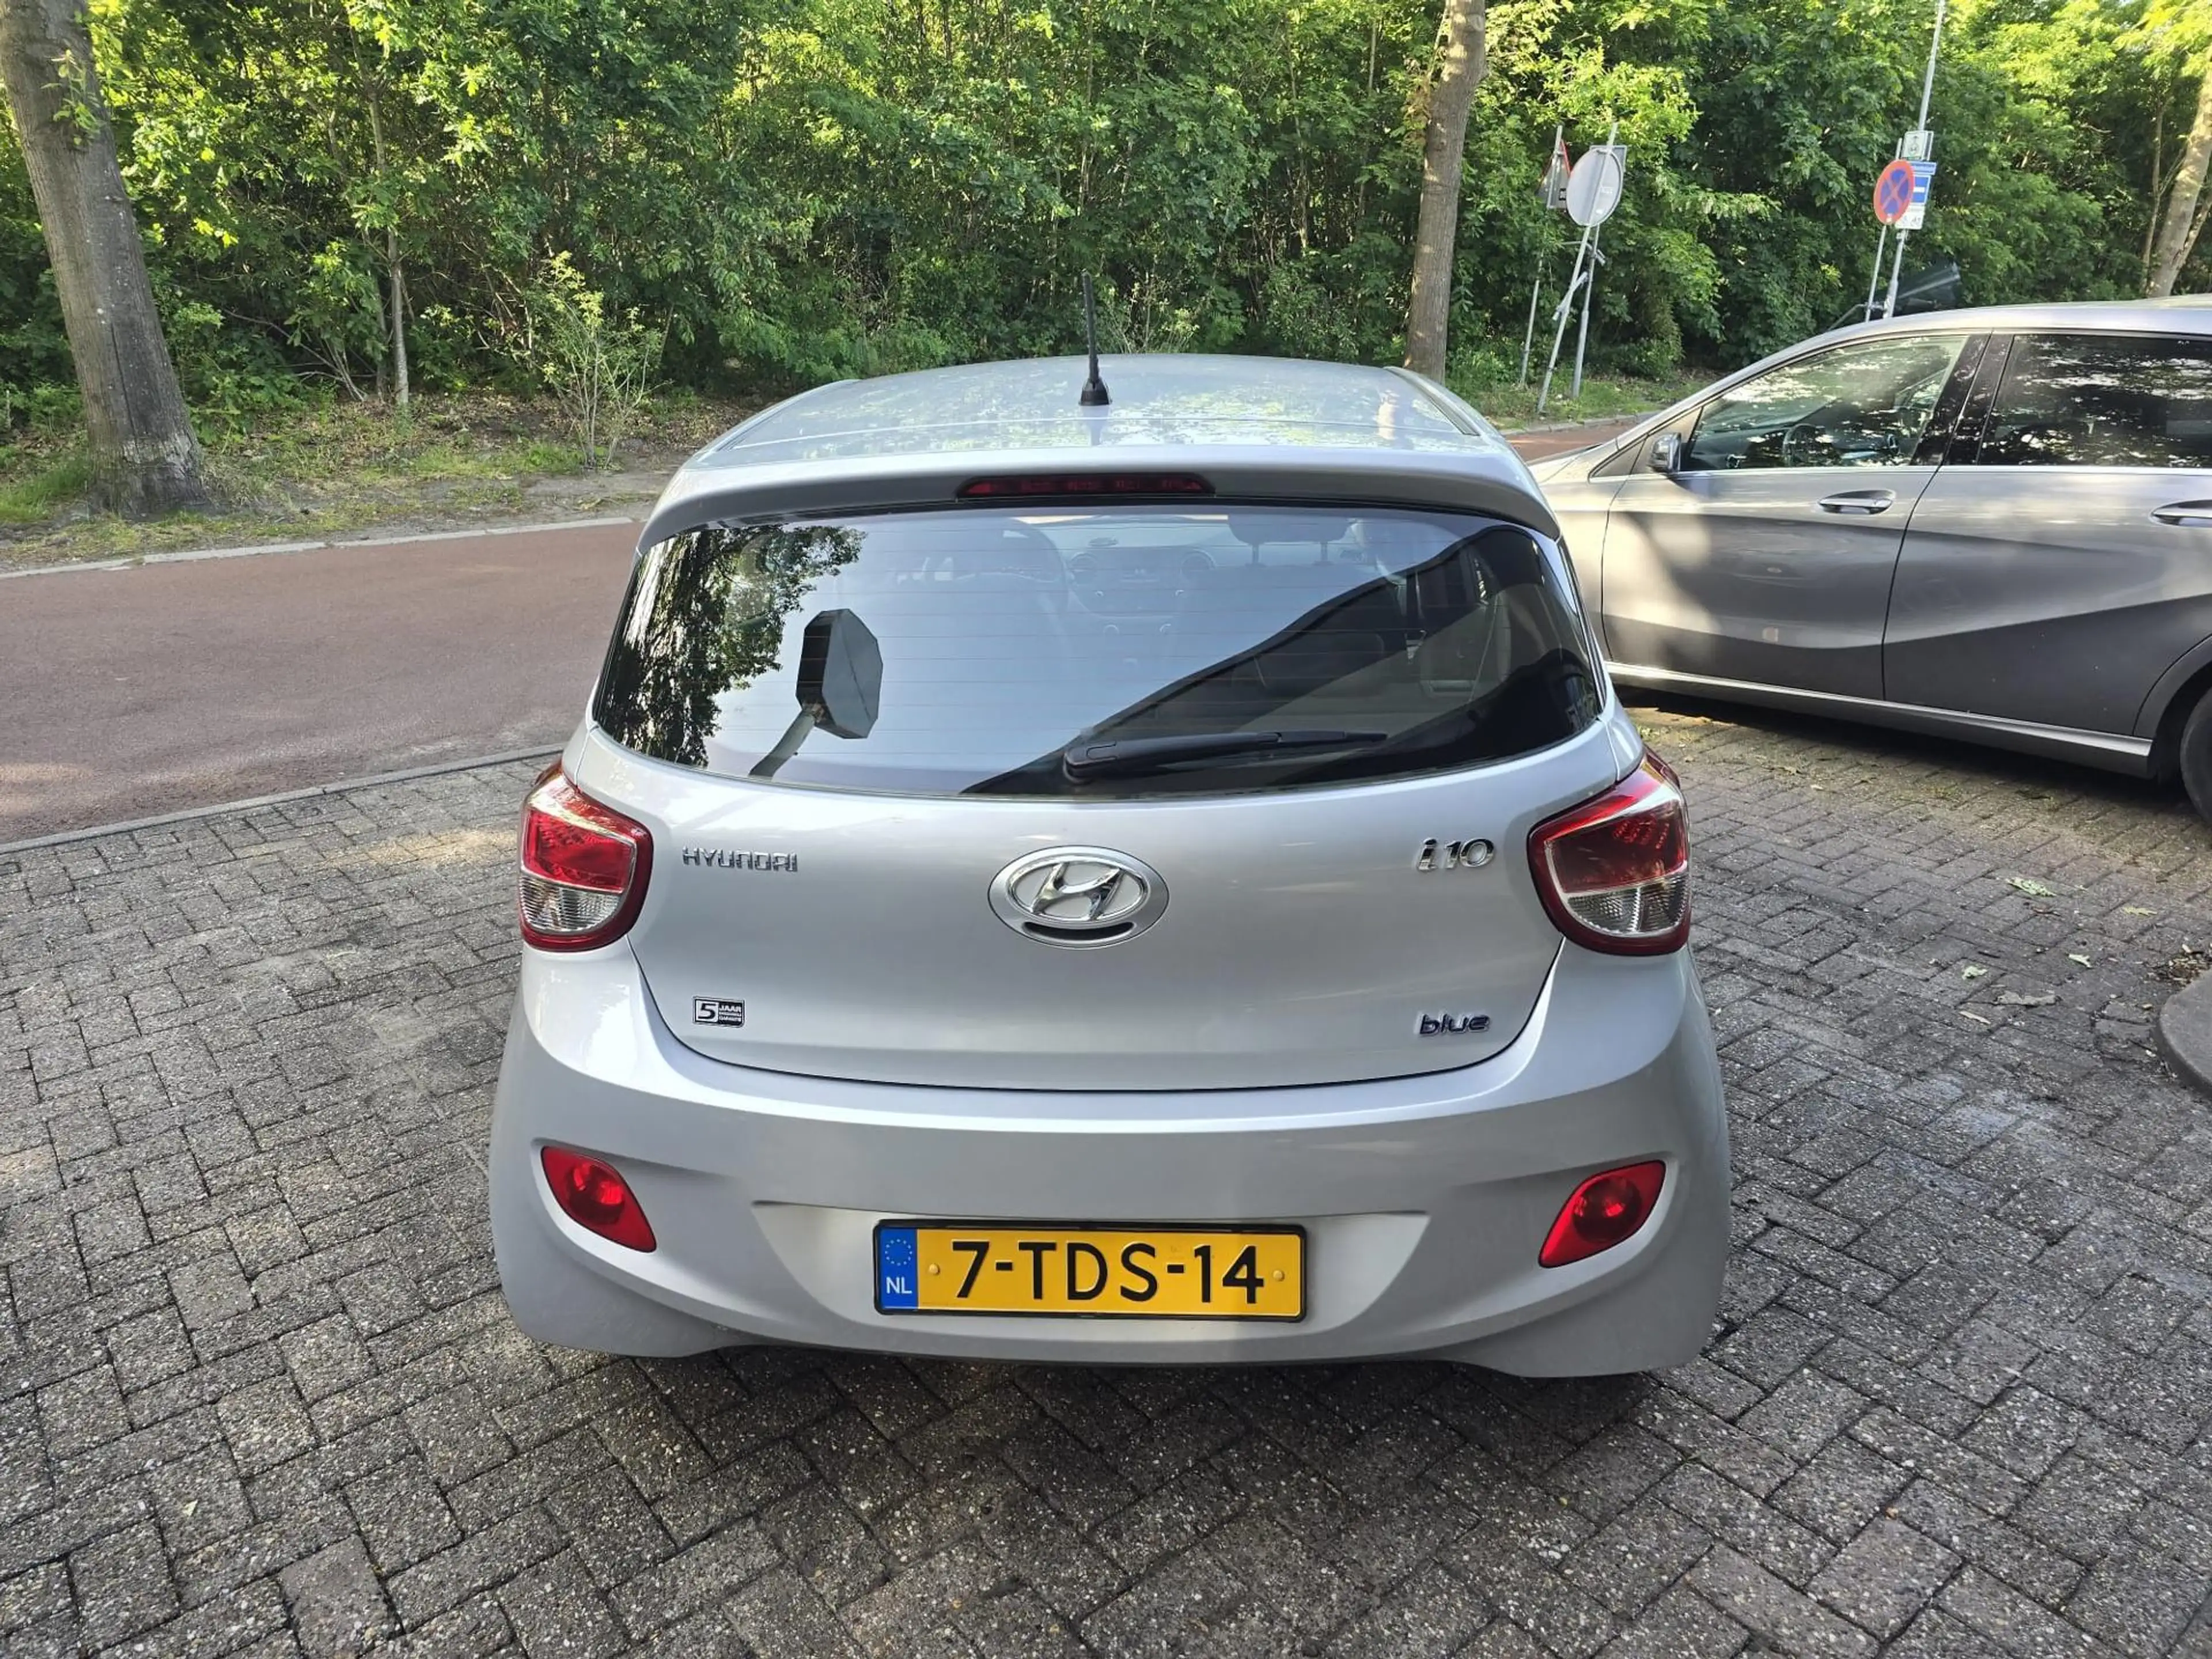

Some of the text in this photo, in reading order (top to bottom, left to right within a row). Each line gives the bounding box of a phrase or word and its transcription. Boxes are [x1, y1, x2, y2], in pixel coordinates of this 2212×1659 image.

[683, 846, 798, 872] HYUNDAI
[698, 1002, 716, 1019] 5
[1419, 1013, 1490, 1035] blue
[952, 1241, 1264, 1304] 7-TDS-14
[886, 1276, 912, 1294] NL
